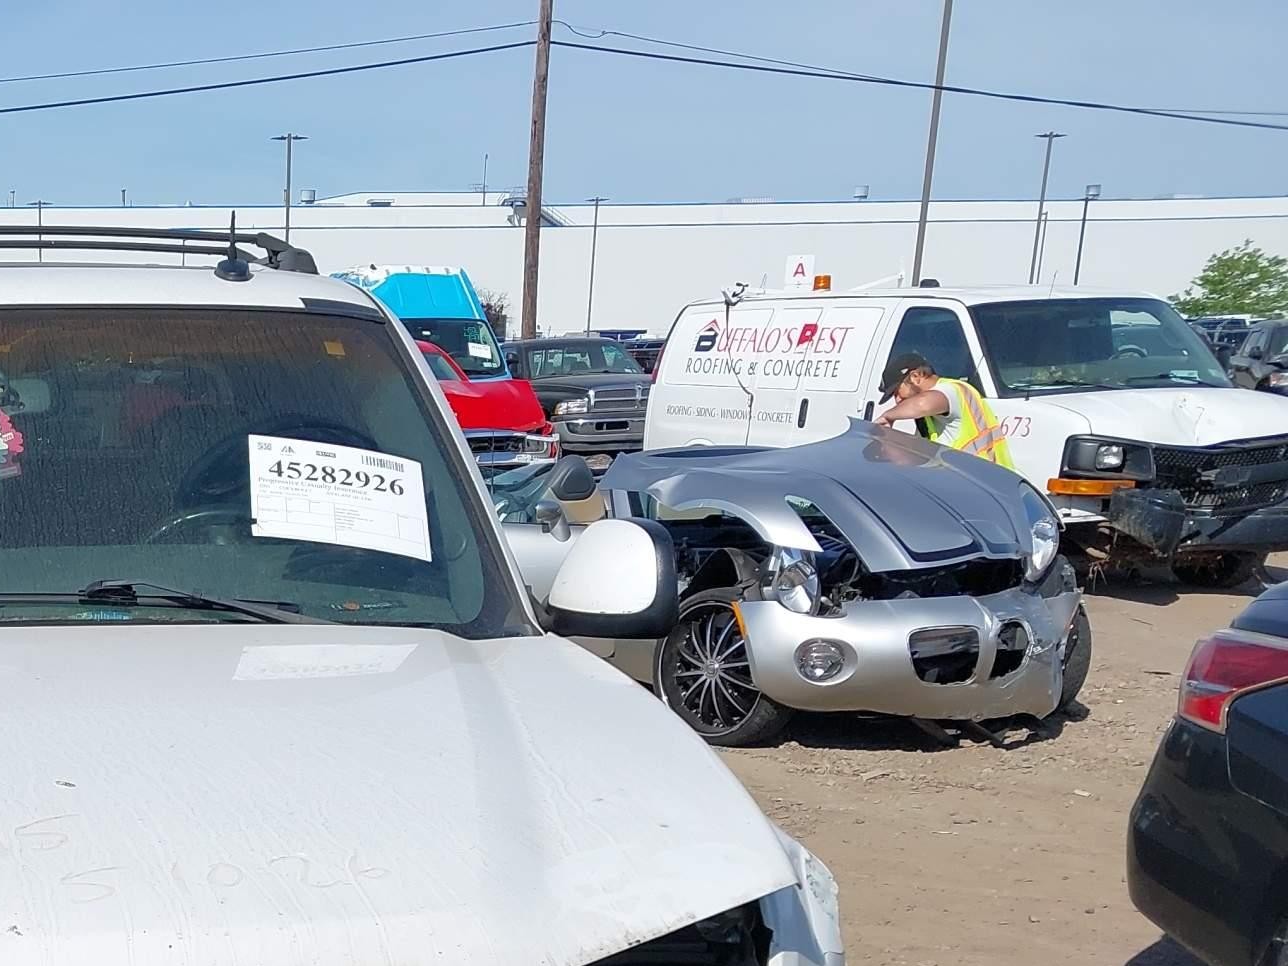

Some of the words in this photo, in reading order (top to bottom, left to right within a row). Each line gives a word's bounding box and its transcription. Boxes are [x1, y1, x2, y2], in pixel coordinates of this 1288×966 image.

[793, 262, 806, 277] A
[694, 323, 798, 354] BUFFALO'S
[685, 357, 742, 375] ROOFING
[747, 363, 757, 376] &
[763, 358, 841, 378] CONCRETE
[665, 405, 692, 416] ROOFING
[695, 407, 716, 418] SIDING
[757, 410, 793, 424] CONCRETE
[995, 415, 1032, 438] 673
[268, 459, 405, 496] 45282926
